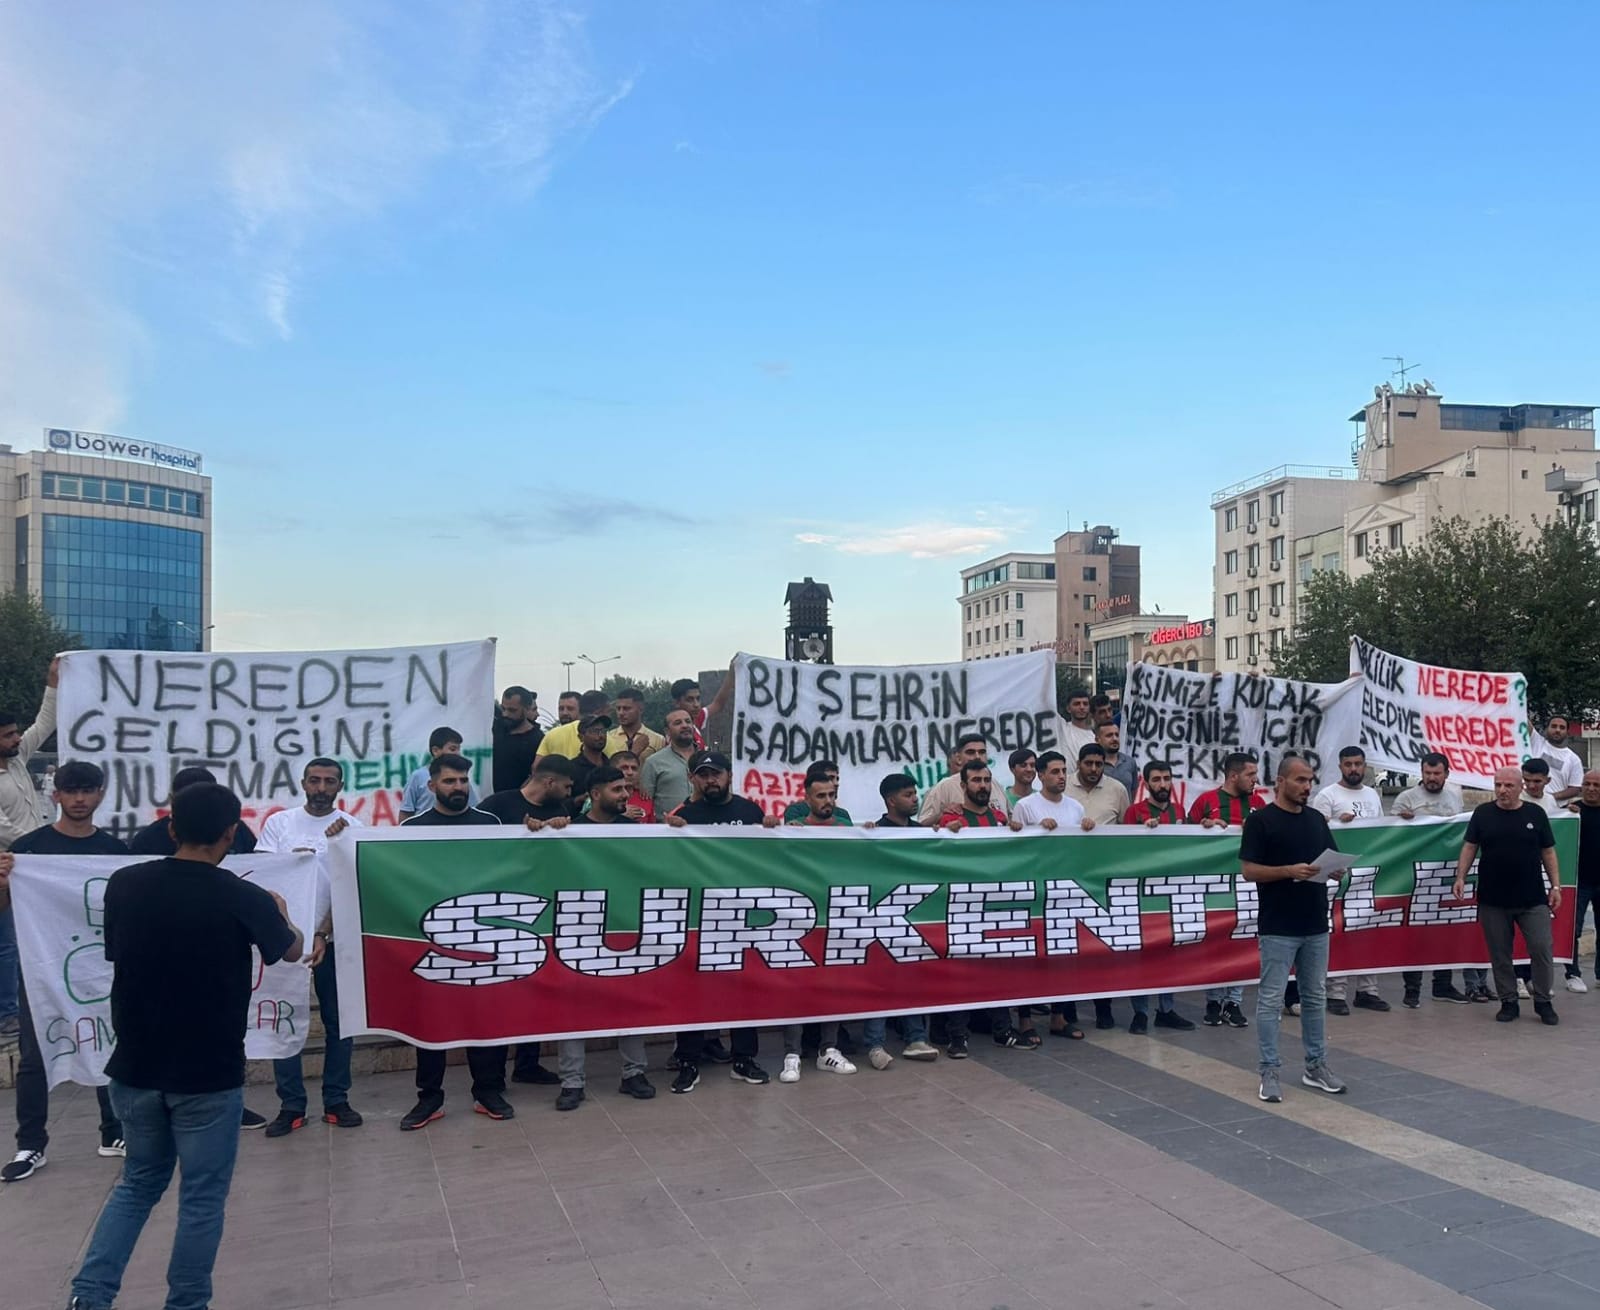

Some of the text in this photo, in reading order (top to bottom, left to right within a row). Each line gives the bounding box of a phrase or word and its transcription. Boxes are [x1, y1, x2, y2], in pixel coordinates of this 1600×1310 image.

[75, 433, 197, 468] bower hospital
[100, 650, 449, 711] NEREDEN
[748, 659, 967, 722] BU ŞEHRİN
[1232, 673, 1323, 715] KULAK
[927, 710, 1057, 759] NEREDE
